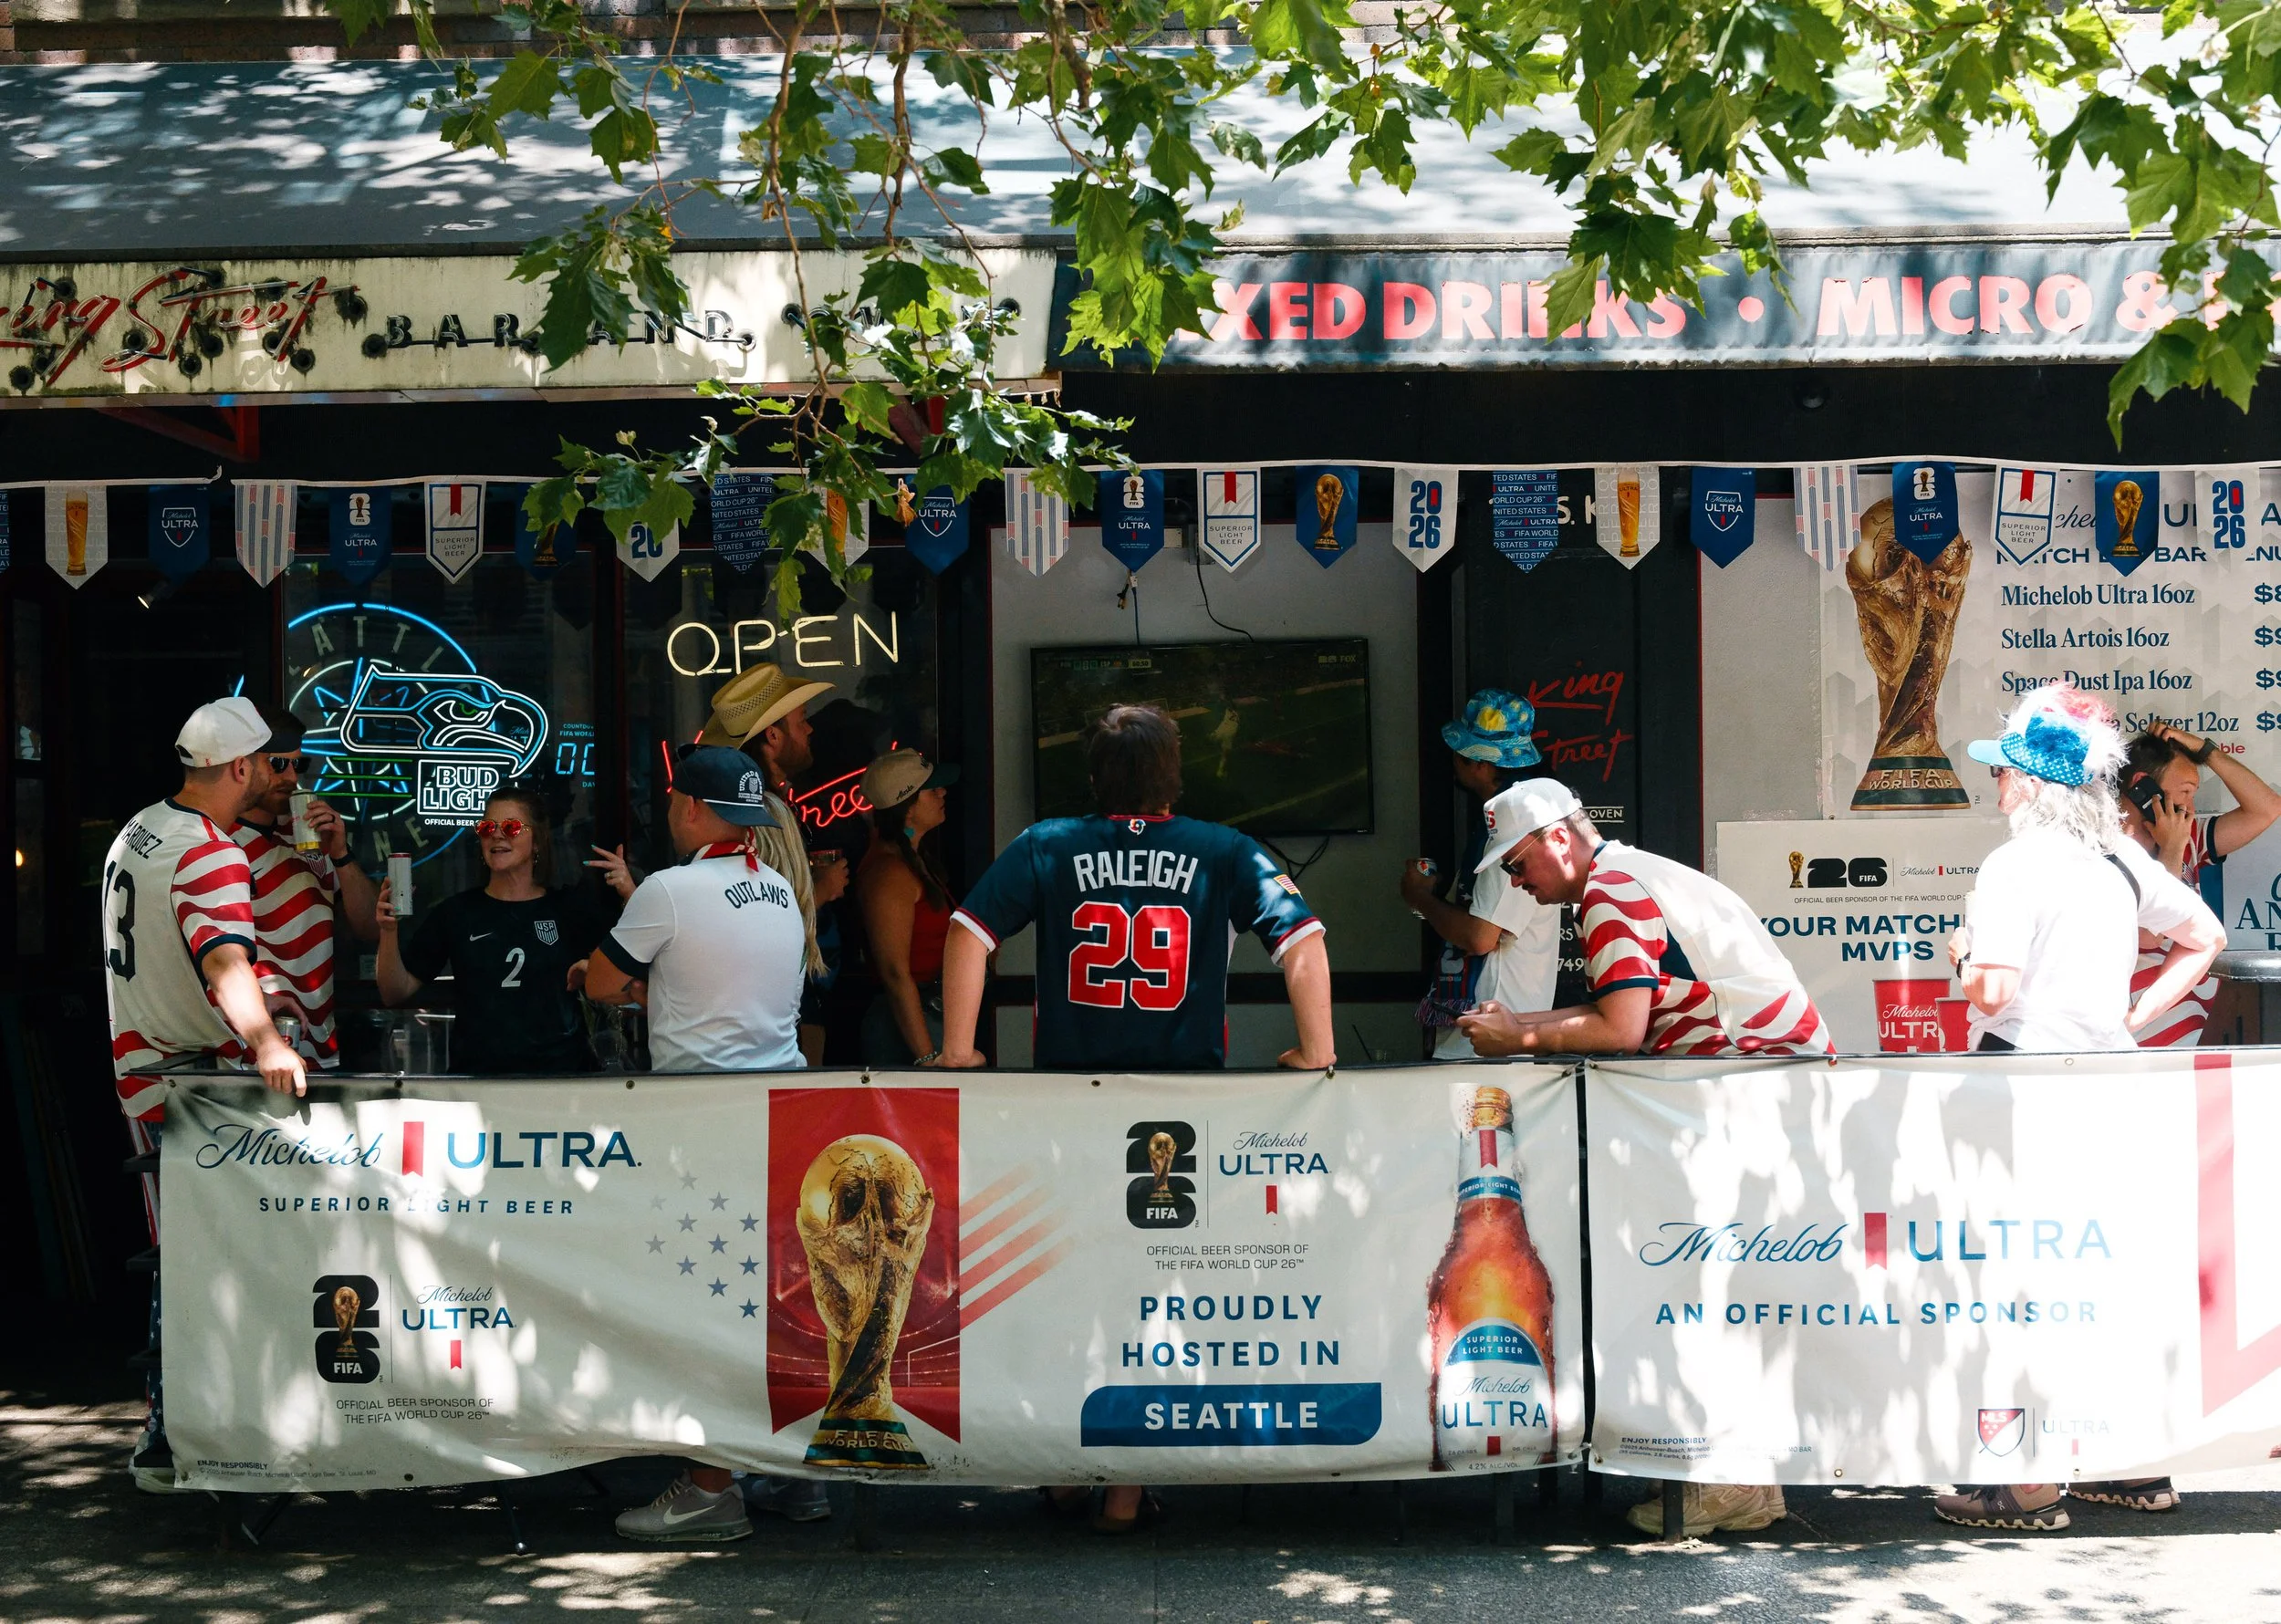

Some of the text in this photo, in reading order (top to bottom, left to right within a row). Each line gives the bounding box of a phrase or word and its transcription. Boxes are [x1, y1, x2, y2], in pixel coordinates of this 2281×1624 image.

[1177, 281, 1367, 341] XED
[1818, 273, 2093, 337] MICRO
[2115, 270, 2179, 332] &
[7, 266, 360, 386] ing Street
[386, 312, 522, 349] BAR
[1410, 480, 1443, 515] 20
[1704, 503, 1744, 513] ULTRA
[2212, 480, 2245, 515] 20
[161, 519, 199, 528] ULTRA
[918, 509, 957, 518] ULTRA
[1909, 512, 1943, 522] ULTRA
[1118, 522, 1151, 530] ULTRA
[1408, 515, 1441, 549] 26
[2001, 522, 2047, 531] SUPERIOR
[2213, 514, 2245, 549] 26
[2154, 547, 2207, 562] BAR
[2001, 582, 2195, 606] Michelob Ultra 16oz
[667, 610, 899, 677] OPEN
[2001, 626, 2171, 650] Stella Artois 16oz
[1527, 660, 1625, 726] King
[2064, 670, 2110, 691] Dust
[2113, 670, 2145, 695] Ipa
[2148, 669, 2192, 691] 16oz
[2197, 711, 2240, 733] 12oz
[1530, 729, 1634, 783] treet
[436, 765, 500, 789] BUD
[1869, 778, 1954, 789] WORLD CUP
[1880, 768, 1942, 779] FIFA
[422, 787, 494, 811] LIGH
[1588, 808, 1623, 819] OVEN
[120, 818, 163, 860] MARQUEZ
[1073, 849, 1199, 895] RALEIGH
[1859, 874, 1878, 882] FIFA
[1946, 866, 1981, 875] ULTRA
[724, 880, 788, 910] OUTLAWS
[536, 921, 555, 932] USA
[1846, 914, 1961, 935] MATCH
[1068, 900, 1192, 1011] 29
[1841, 941, 1934, 962] MVPS
[501, 947, 526, 988] 2
[1878, 1021, 1940, 1039] ULTR
[196, 1124, 384, 1170] Michelob
[1233, 1130, 1308, 1150] Michelob
[1219, 1152, 1329, 1176] ULTRA
[259, 1196, 390, 1213] SUPERIOR
[506, 1200, 573, 1214] BEER
[1146, 1207, 1179, 1220] FIFA
[1146, 1244, 1309, 1256] OFFICIAL BEER SPONSOR OF
[1640, 1219, 2113, 1267] Michelob ULTRA
[1155, 1260, 1178, 1270] THE
[1180, 1260, 1204, 1270] FIFA
[1207, 1259, 1251, 1269] WORLD
[1253, 1259, 1278, 1269] CUP
[416, 1285, 494, 1305] Michelob
[402, 1306, 515, 1331] ULTRA
[1140, 1295, 1323, 1321] PROUDLY
[1655, 1301, 2097, 1326] AN OFFICIAL SPONSOR
[1463, 1346, 1523, 1355] LIGHT BEER
[1466, 1335, 1518, 1344] SUPERIOR
[1122, 1340, 1339, 1368] HOSTED IN
[333, 1361, 363, 1375] FIFA
[1455, 1375, 1530, 1397] Michelob
[336, 1398, 494, 1411] OFFICIAL BEER SPONSOR OF
[1443, 1400, 1548, 1430] ULTRA
[344, 1414, 365, 1424] THE
[368, 1413, 392, 1424] FIFA
[395, 1410, 438, 1421] WORLD
[441, 1410, 464, 1420] CUP
[1144, 1401, 1318, 1431] SEATTLE
[1981, 1411, 2111, 1433] MLS ULTRA
[824, 1438, 878, 1449] WORLD
[834, 1429, 895, 1440] FIFA
[1652, 1437, 1707, 1445] RESPONSIBLY
[197, 1460, 268, 1470] ENJOY RESPONSIBLY
